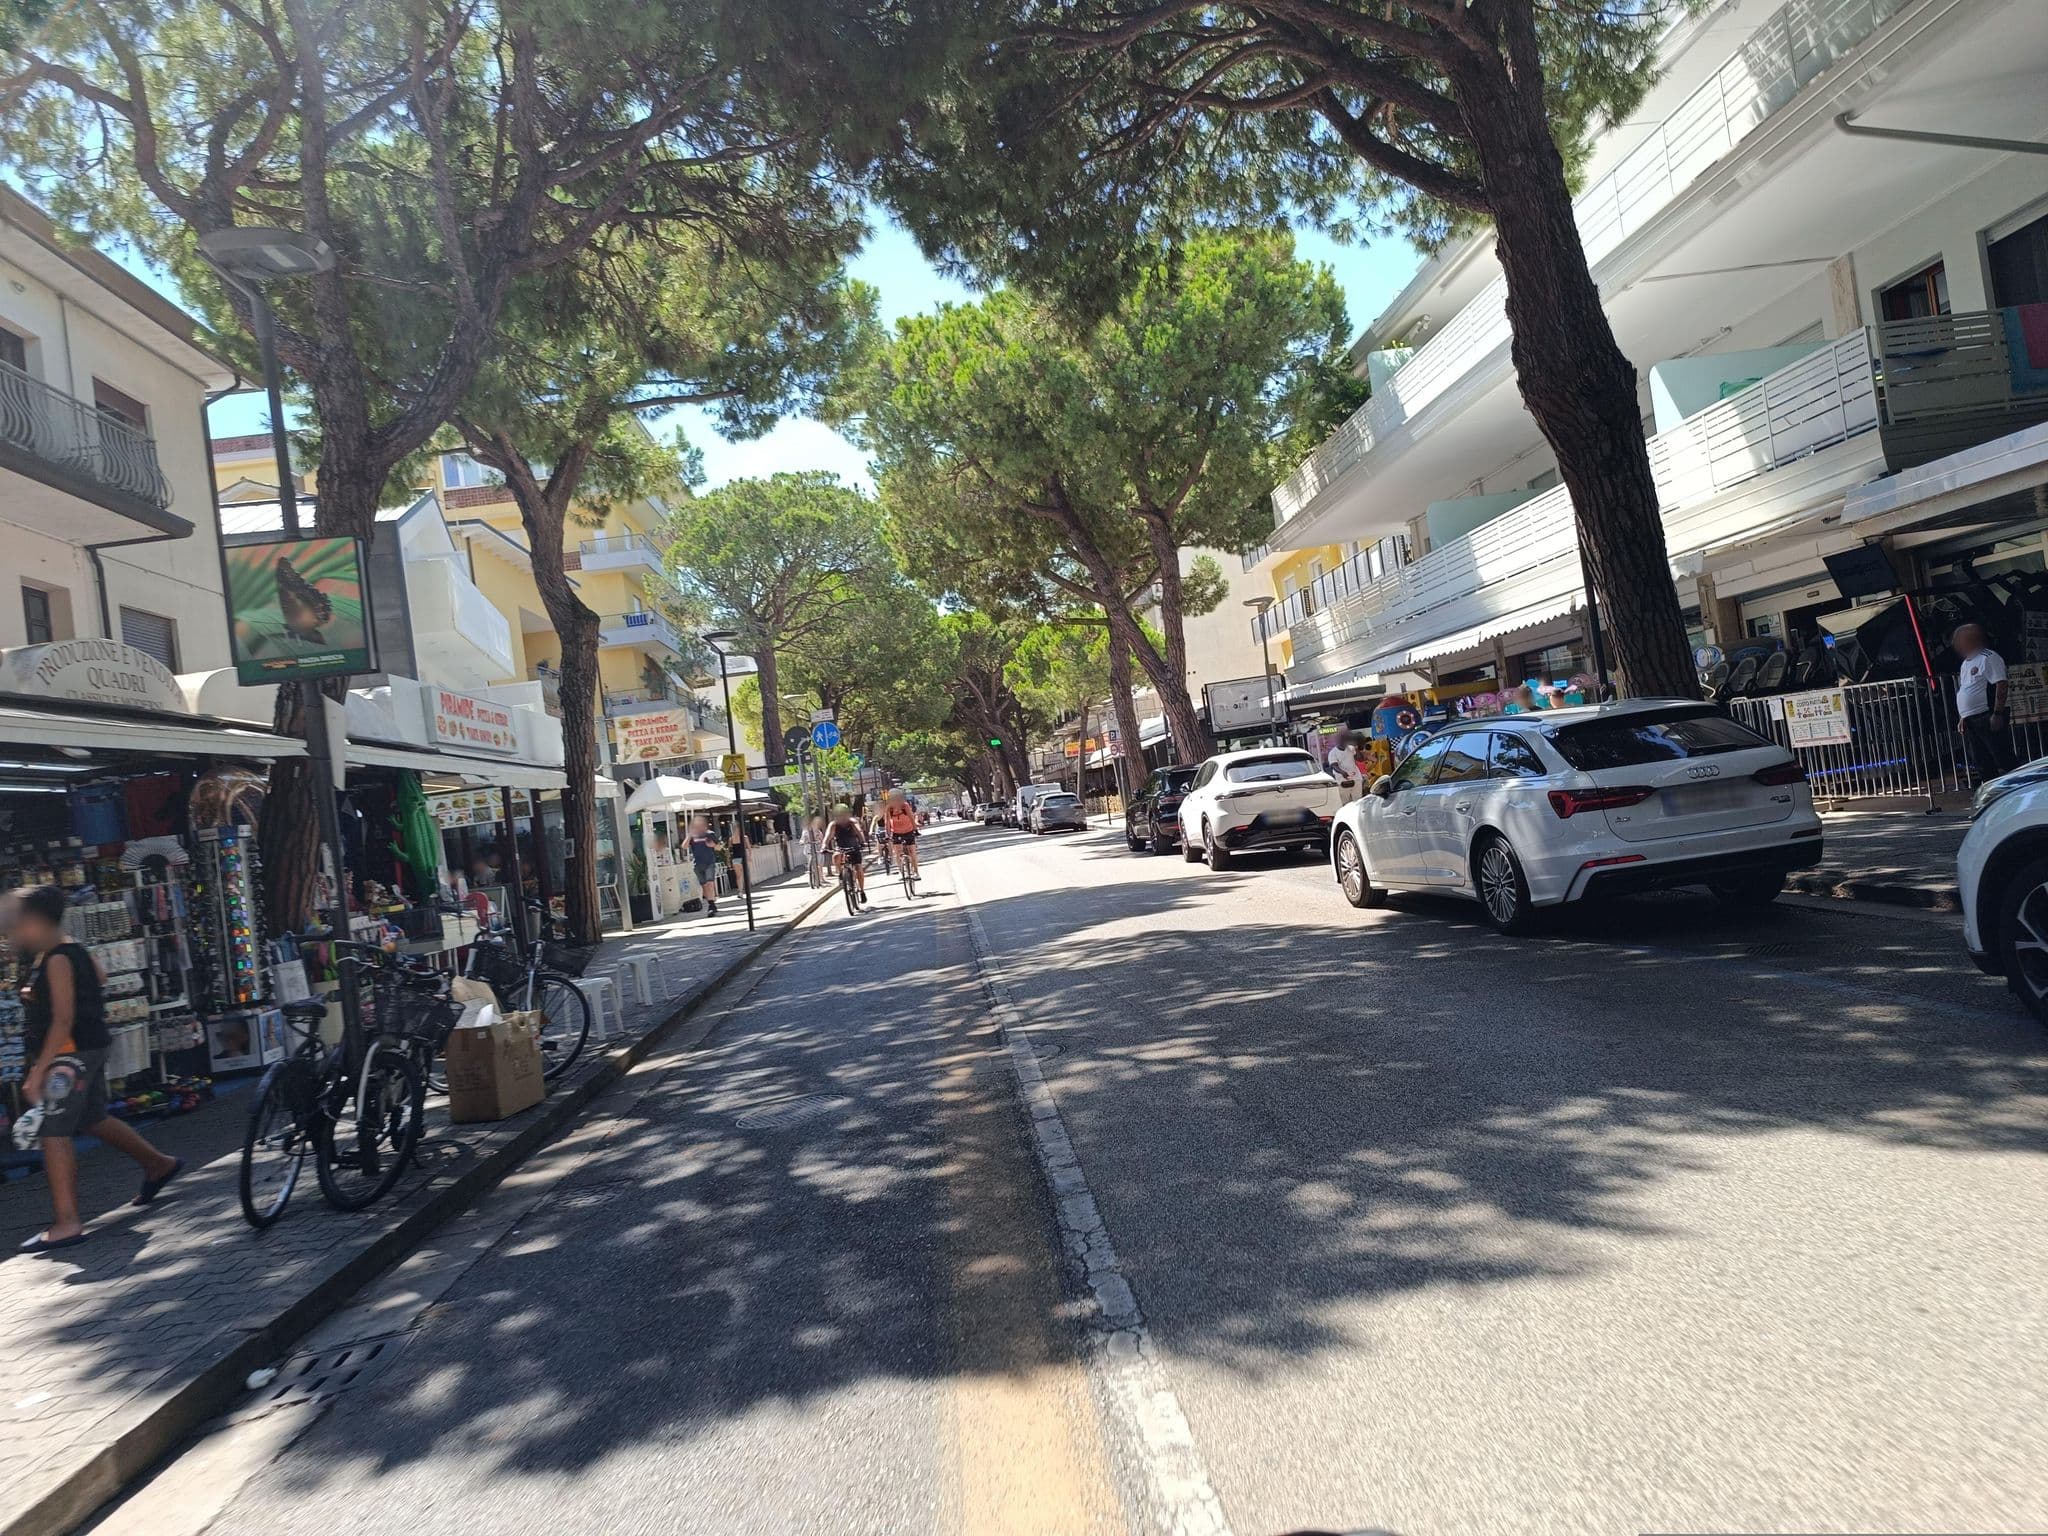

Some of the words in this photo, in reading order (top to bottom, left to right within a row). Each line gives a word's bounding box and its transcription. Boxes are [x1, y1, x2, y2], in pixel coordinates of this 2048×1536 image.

[36, 641, 119, 686] PRODUZIONE
[120, 645, 130, 665] E
[86, 666, 146, 693] QUADRI
[440, 692, 474, 720] PIRAMIDE
[635, 715, 669, 726] PIRAMIDE
[627, 729, 649, 738] PIZZA
[656, 724, 679, 734] KEBAB
[634, 737, 653, 747] TAKE
[654, 735, 674, 744] AWAY
